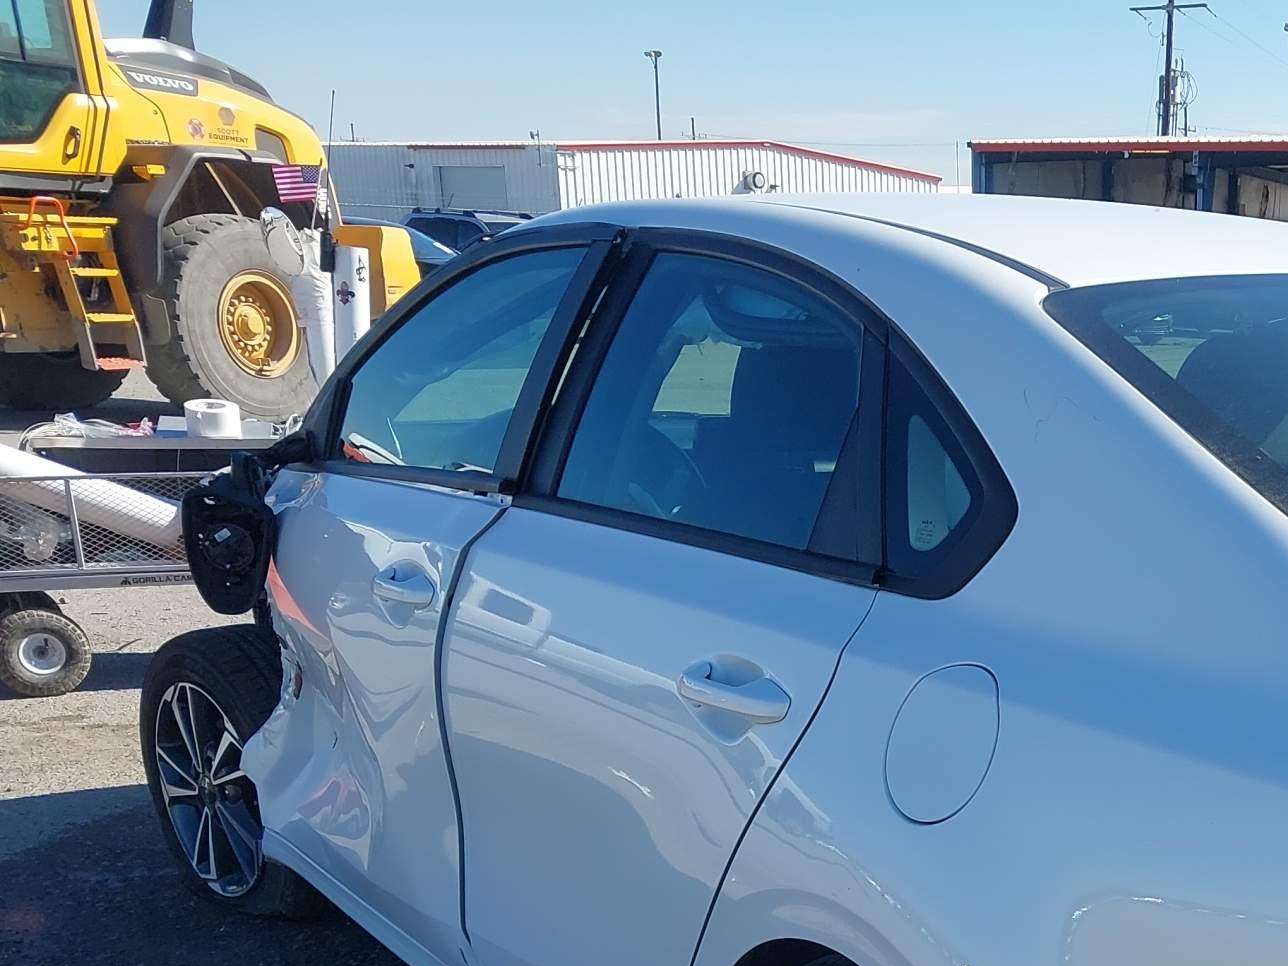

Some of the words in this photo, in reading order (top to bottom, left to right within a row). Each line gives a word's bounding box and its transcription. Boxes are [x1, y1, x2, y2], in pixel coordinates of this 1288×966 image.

[126, 71, 194, 91] VOLVO
[208, 132, 249, 144] EQUIPMENT
[132, 576, 172, 584] GORILLA
